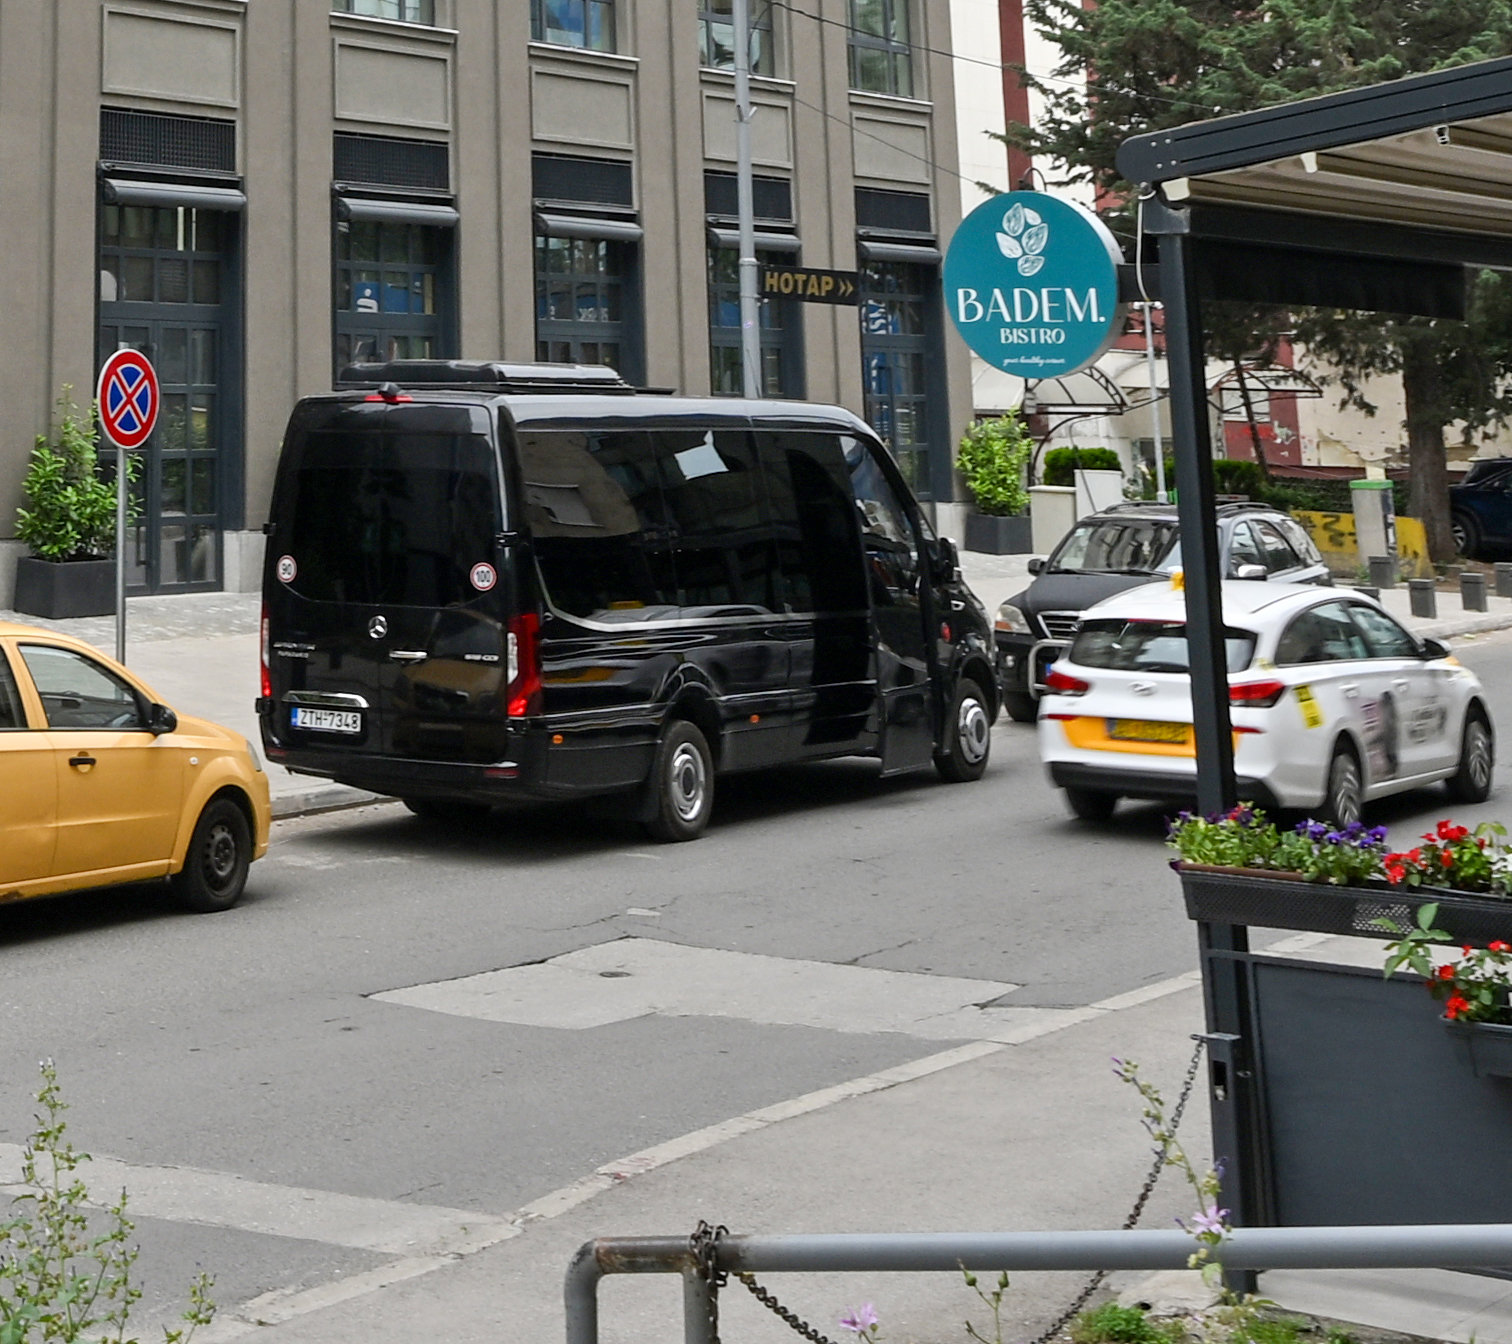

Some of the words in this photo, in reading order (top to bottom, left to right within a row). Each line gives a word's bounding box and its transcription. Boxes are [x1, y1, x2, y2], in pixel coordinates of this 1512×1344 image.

[764, 271, 834, 296] НОТАР
[957, 287, 1107, 323] BADEM.
[1000, 328, 1066, 345] BISTRO
[281, 562, 292, 576] 90
[476, 569, 491, 584] 100
[300, 709, 359, 729] ZTH-7348
